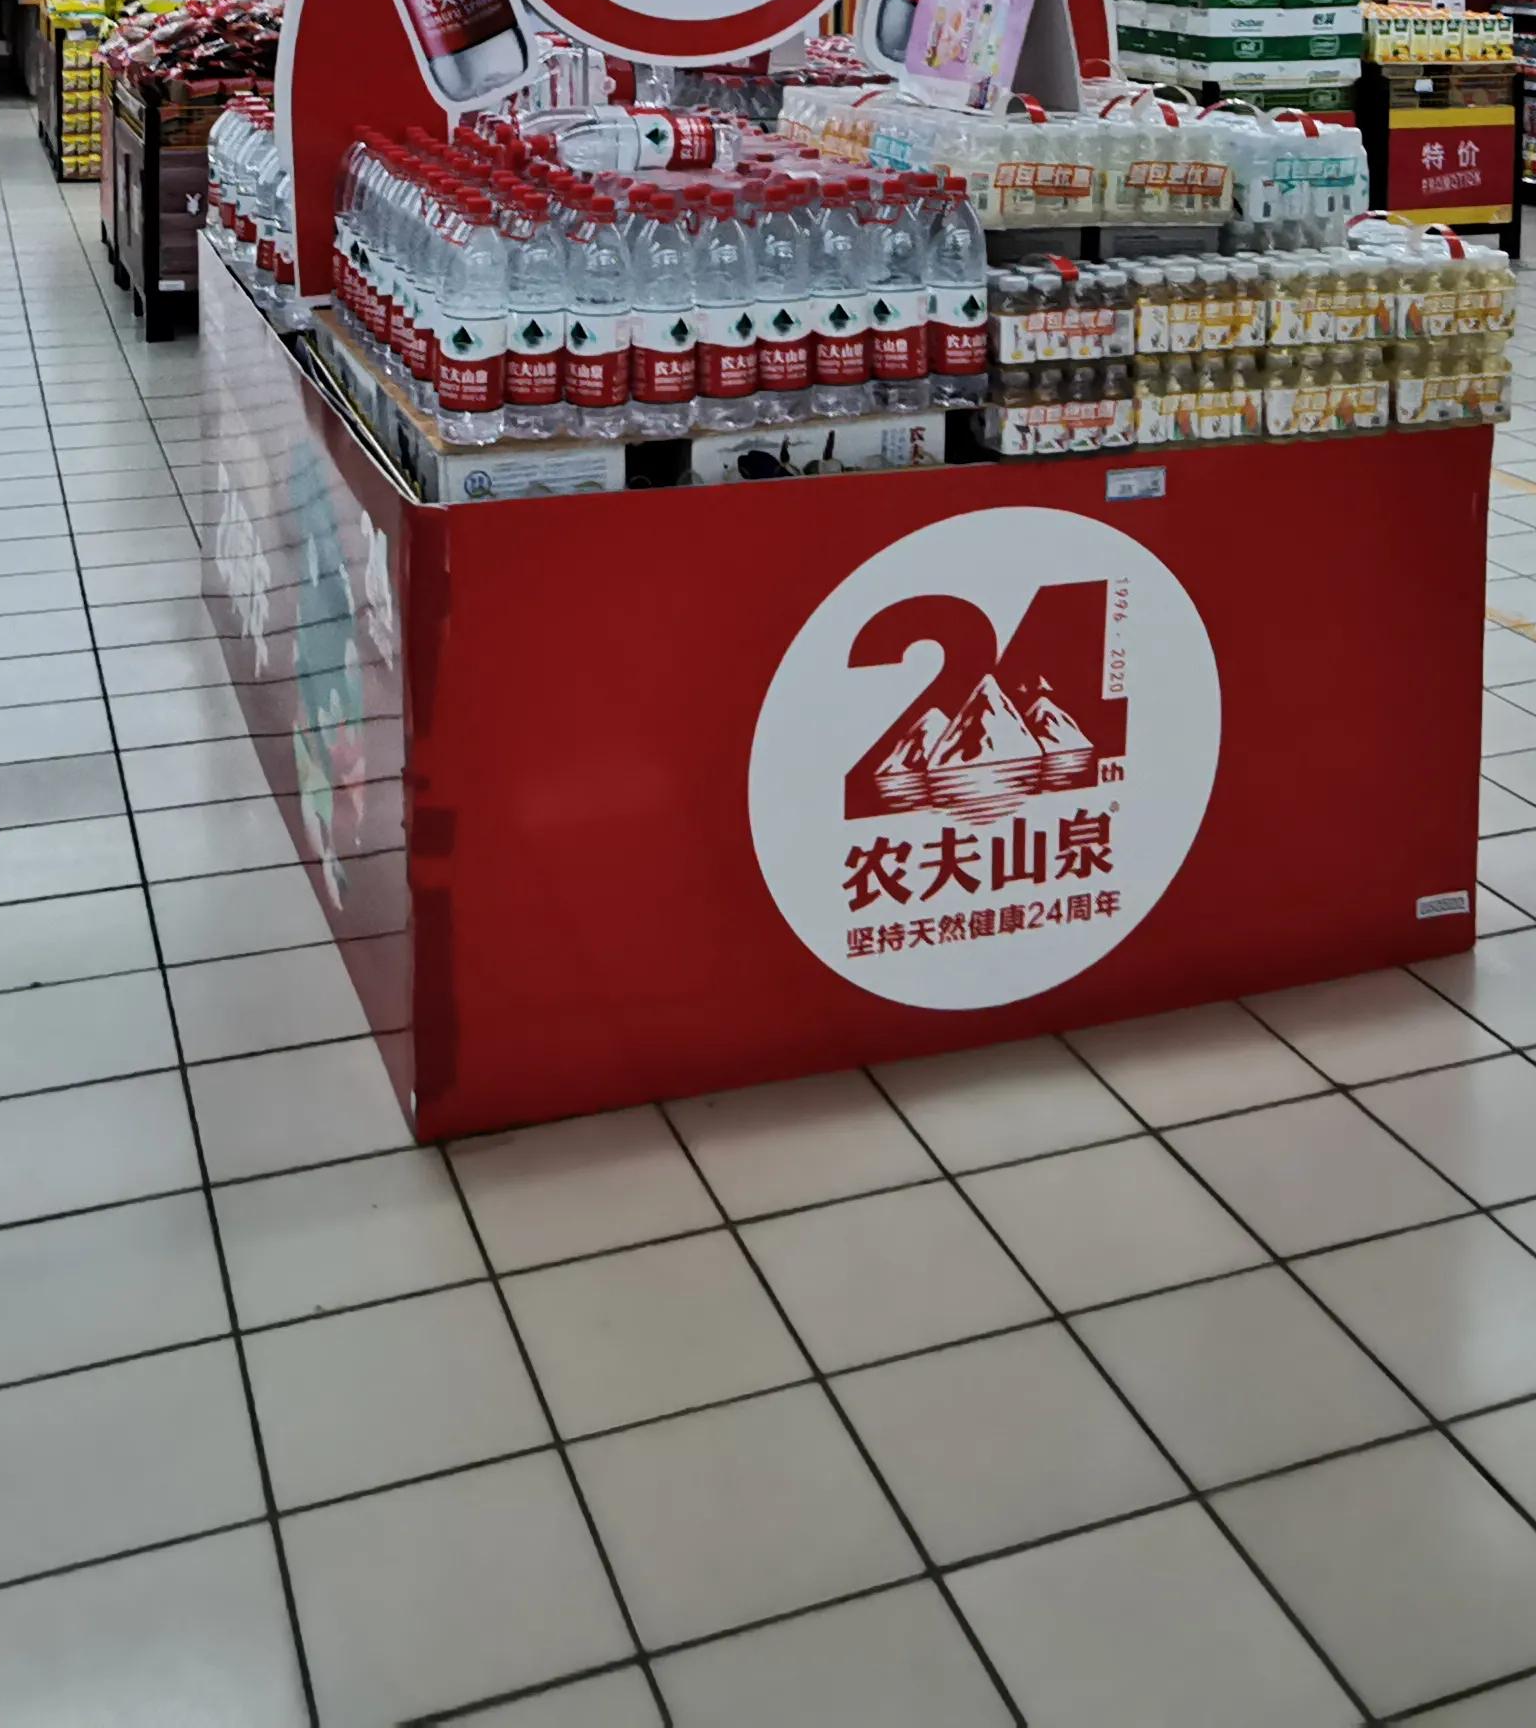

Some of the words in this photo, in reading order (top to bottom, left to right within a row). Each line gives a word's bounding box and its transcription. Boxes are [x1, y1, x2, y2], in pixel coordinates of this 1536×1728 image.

[1421, 140, 1480, 170] 特价
[842, 808, 1114, 914] 农夫山泉
[846, 890, 1121, 960] 坚持天然健康24周年
